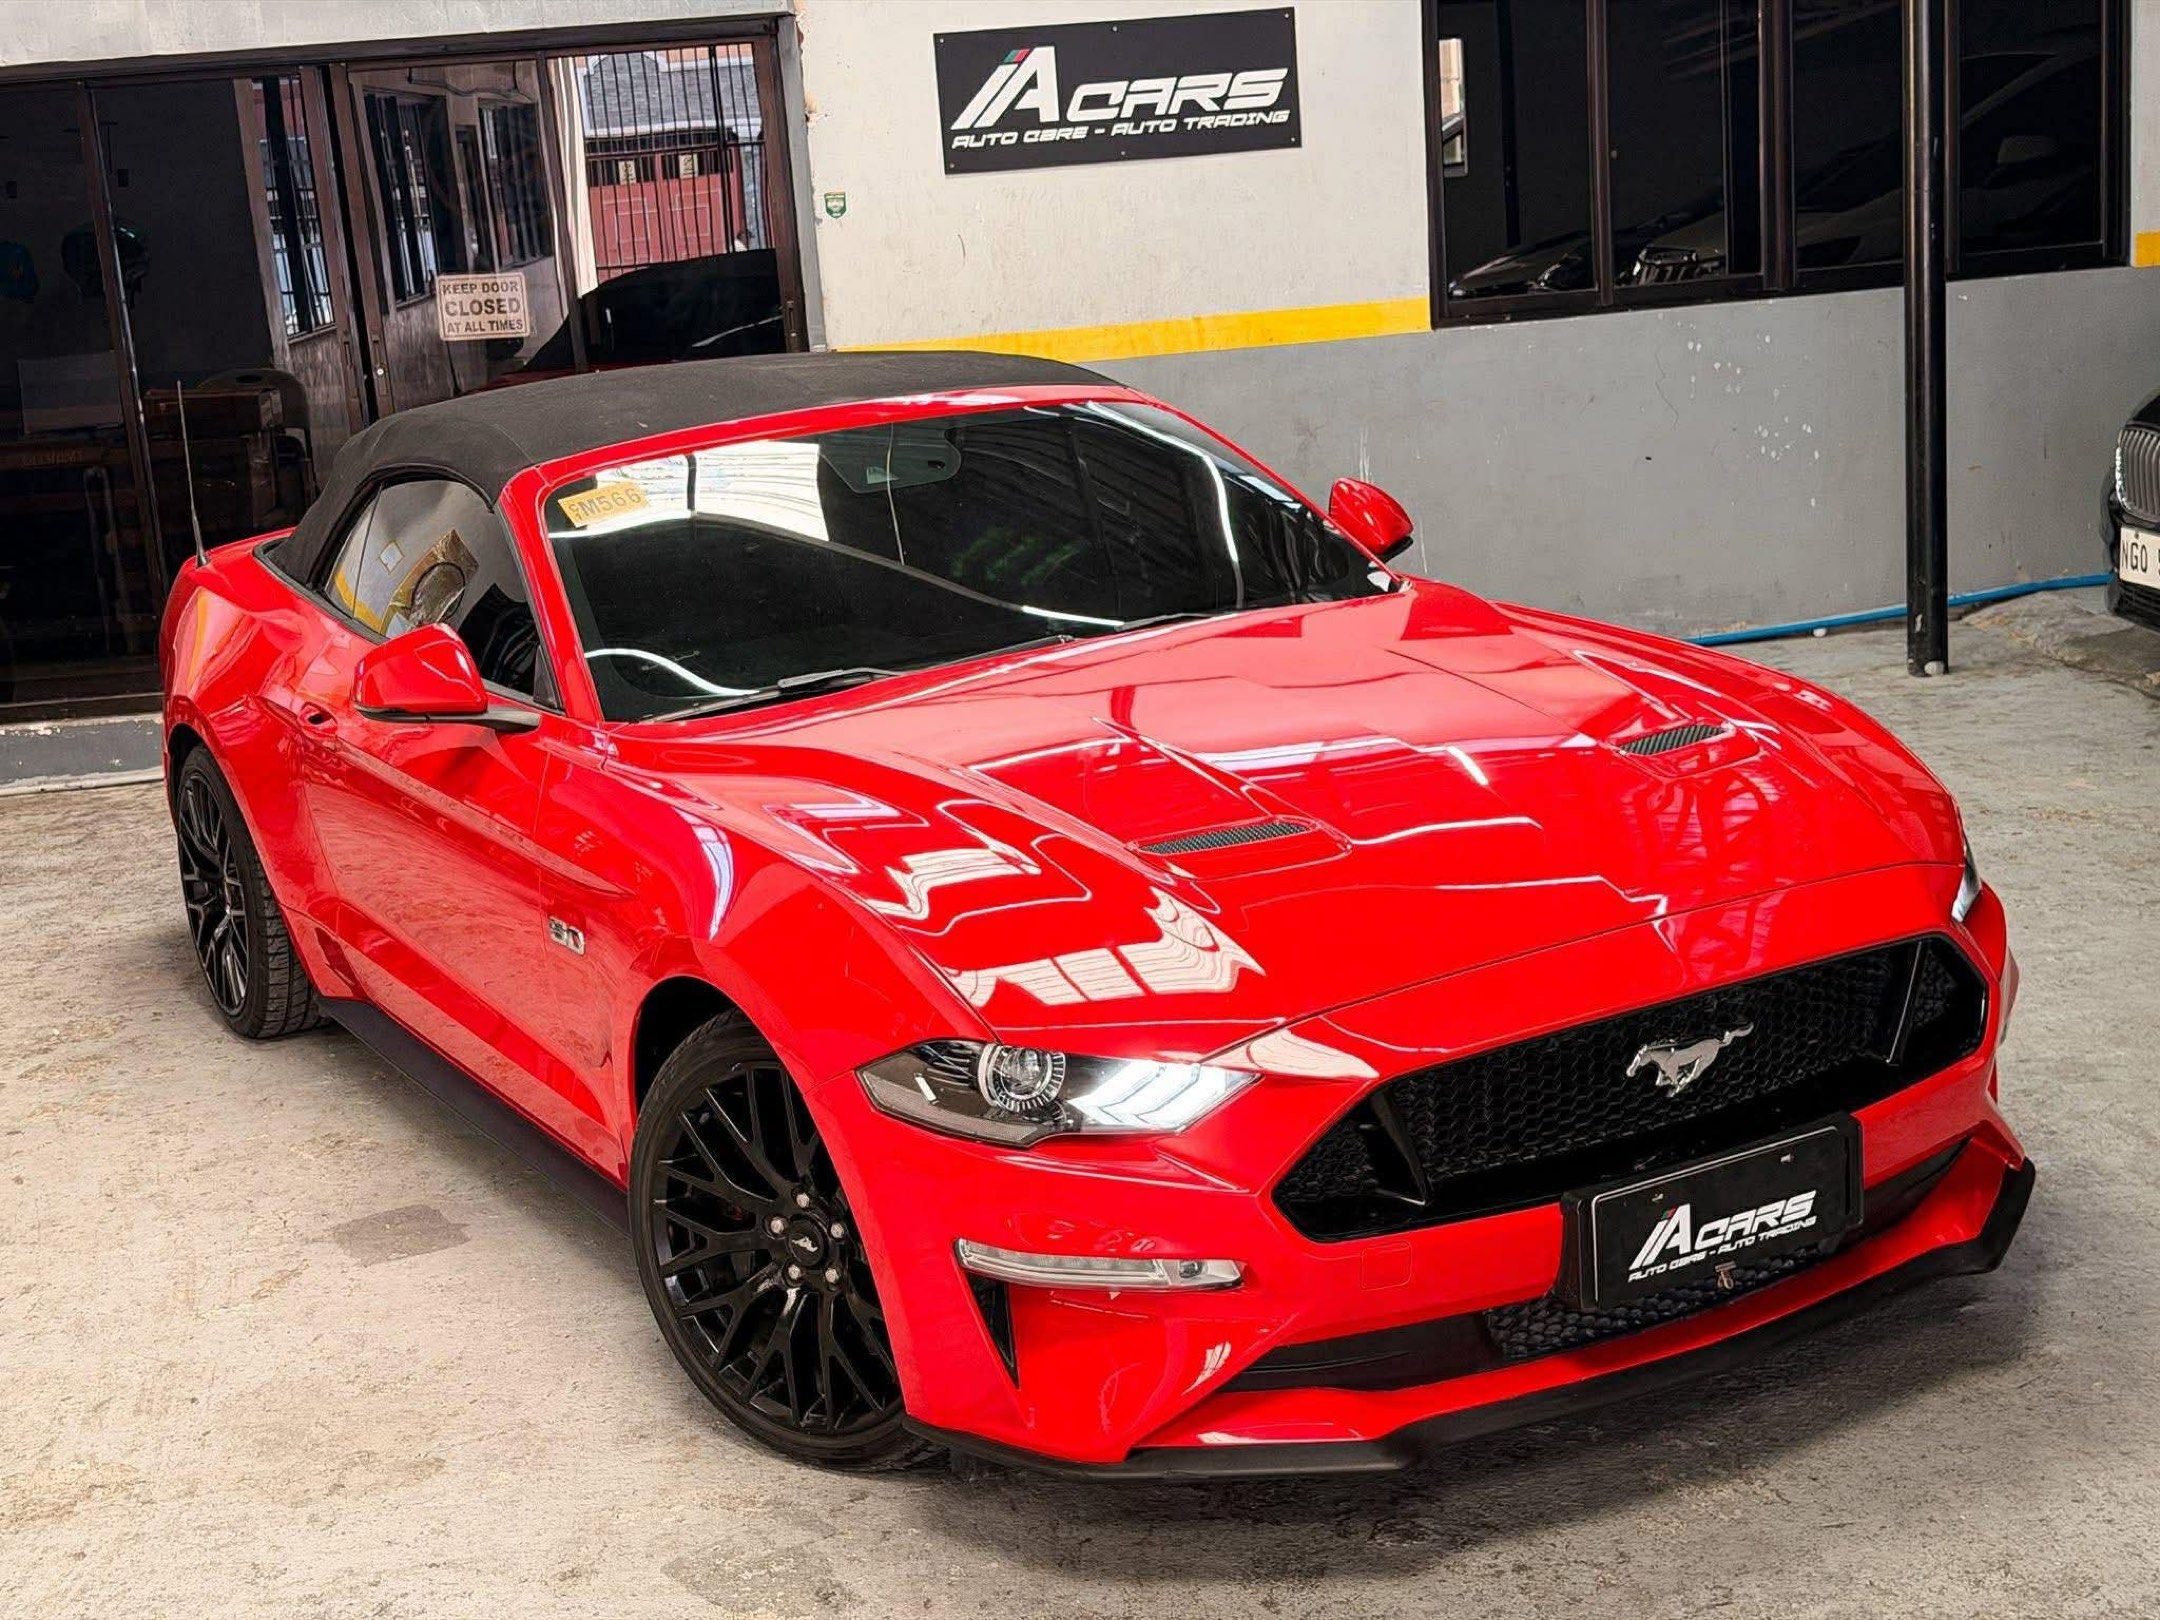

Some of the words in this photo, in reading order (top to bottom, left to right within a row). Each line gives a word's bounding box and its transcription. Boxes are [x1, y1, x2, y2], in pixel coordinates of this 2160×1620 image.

[951, 132, 1018, 149] AUTO
[1111, 118, 1176, 136] AUTO
[1182, 109, 1290, 131] TRADING
[442, 283, 477, 294] KEEP
[482, 281, 519, 293] DOOR
[444, 298, 521, 316] CLOSED
[447, 322, 461, 333] AT
[464, 321, 486, 332] ALL
[488, 319, 523, 331] TIMES
[1694, 1189, 1817, 1250] CARS
[1628, 1263, 1667, 1283] AUTO
[1718, 1236, 1756, 1254] AUTO
